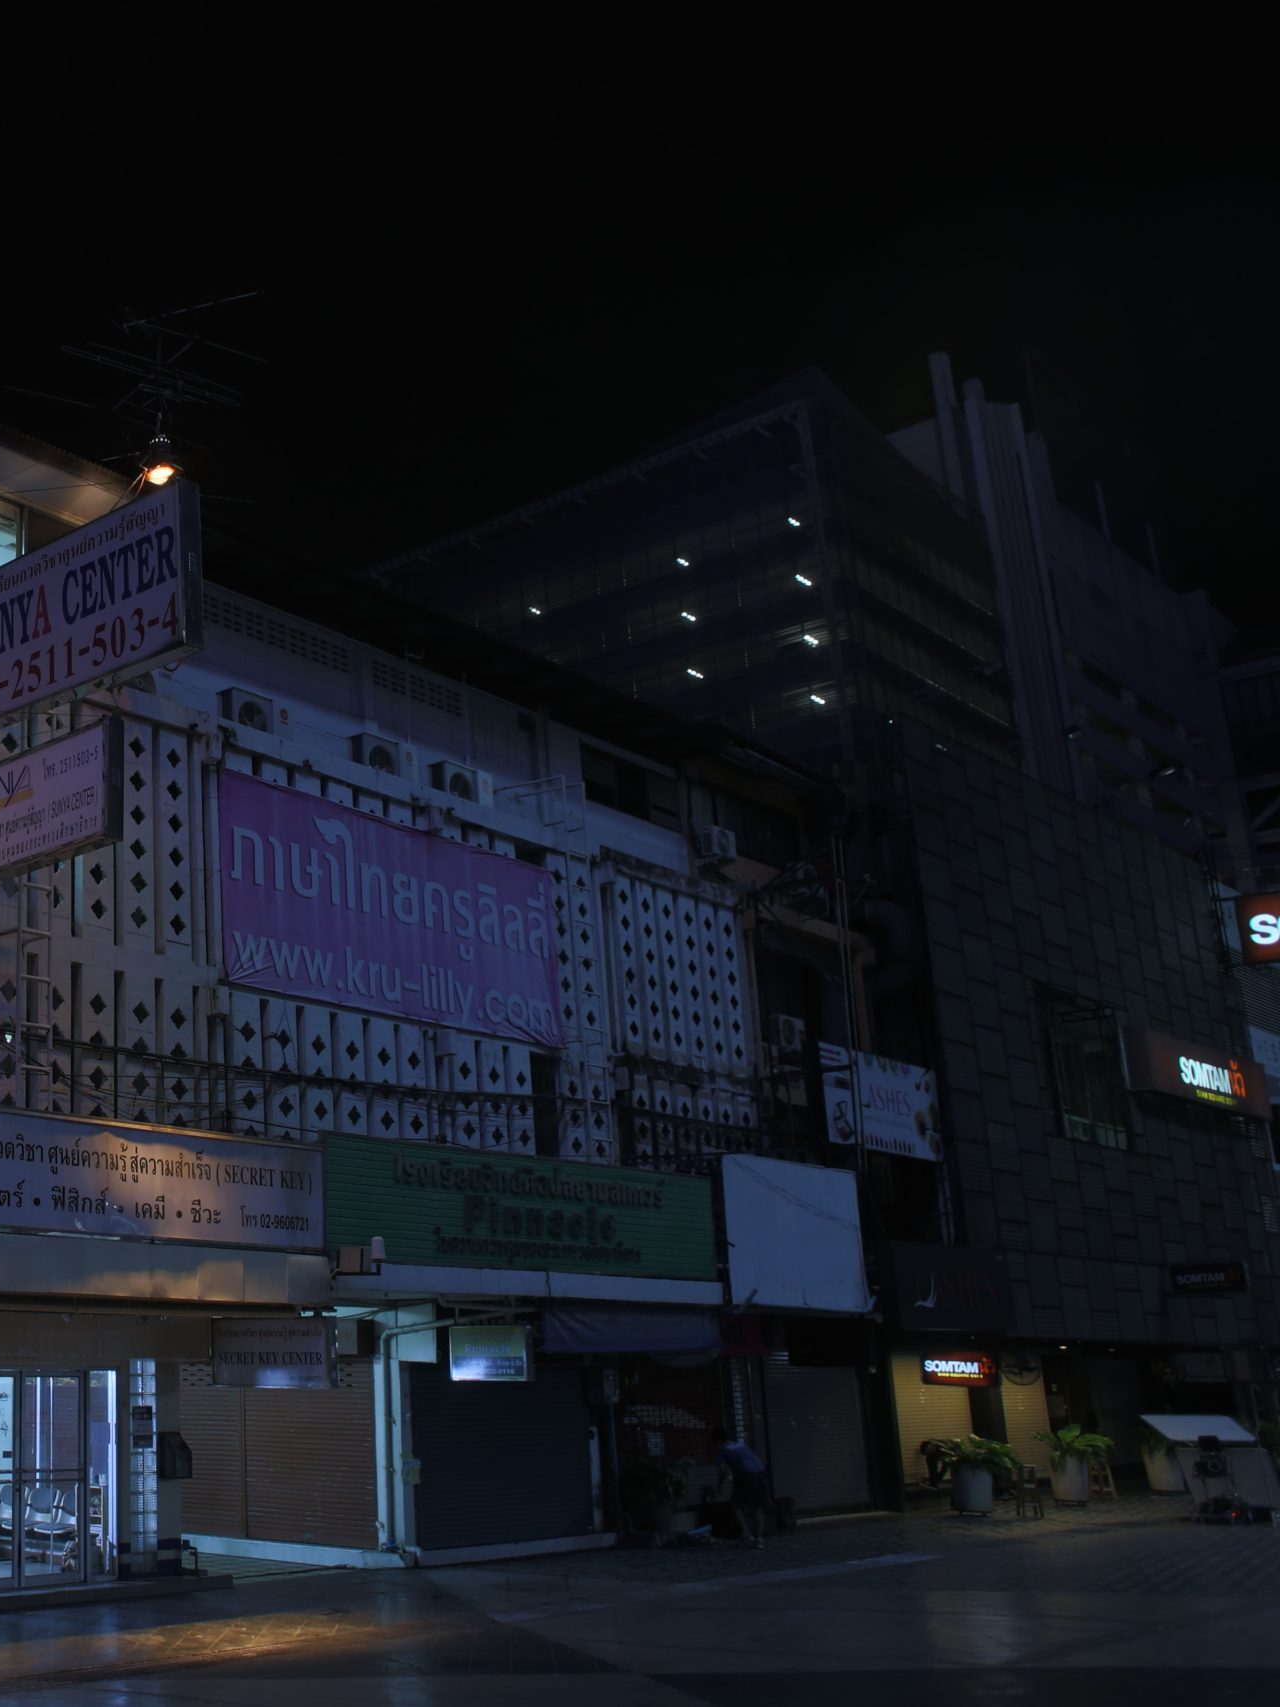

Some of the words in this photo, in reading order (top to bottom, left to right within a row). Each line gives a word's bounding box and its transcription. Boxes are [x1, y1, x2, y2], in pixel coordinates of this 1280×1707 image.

[62, 525, 178, 625] CENTER
[231, 930, 560, 1043] www.kru-lilly.com
[1179, 1056, 1232, 1095] SOMTAM
[48, 1136, 128, 1183] ศูนย์ความรู้
[129, 1145, 212, 1184] สู่ความสำเร็จ
[50, 1186, 110, 1216] ฟิสิกส์
[134, 1194, 166, 1221] เคมี
[189, 1199, 222, 1225] ชีวะ
[1175, 1271, 1225, 1286] SOMTAM
[217, 1351, 257, 1366] SECRET
[258, 1351, 279, 1366] KEY
[281, 1351, 323, 1366] CENTER
[924, 1360, 979, 1373] SOMTAM
